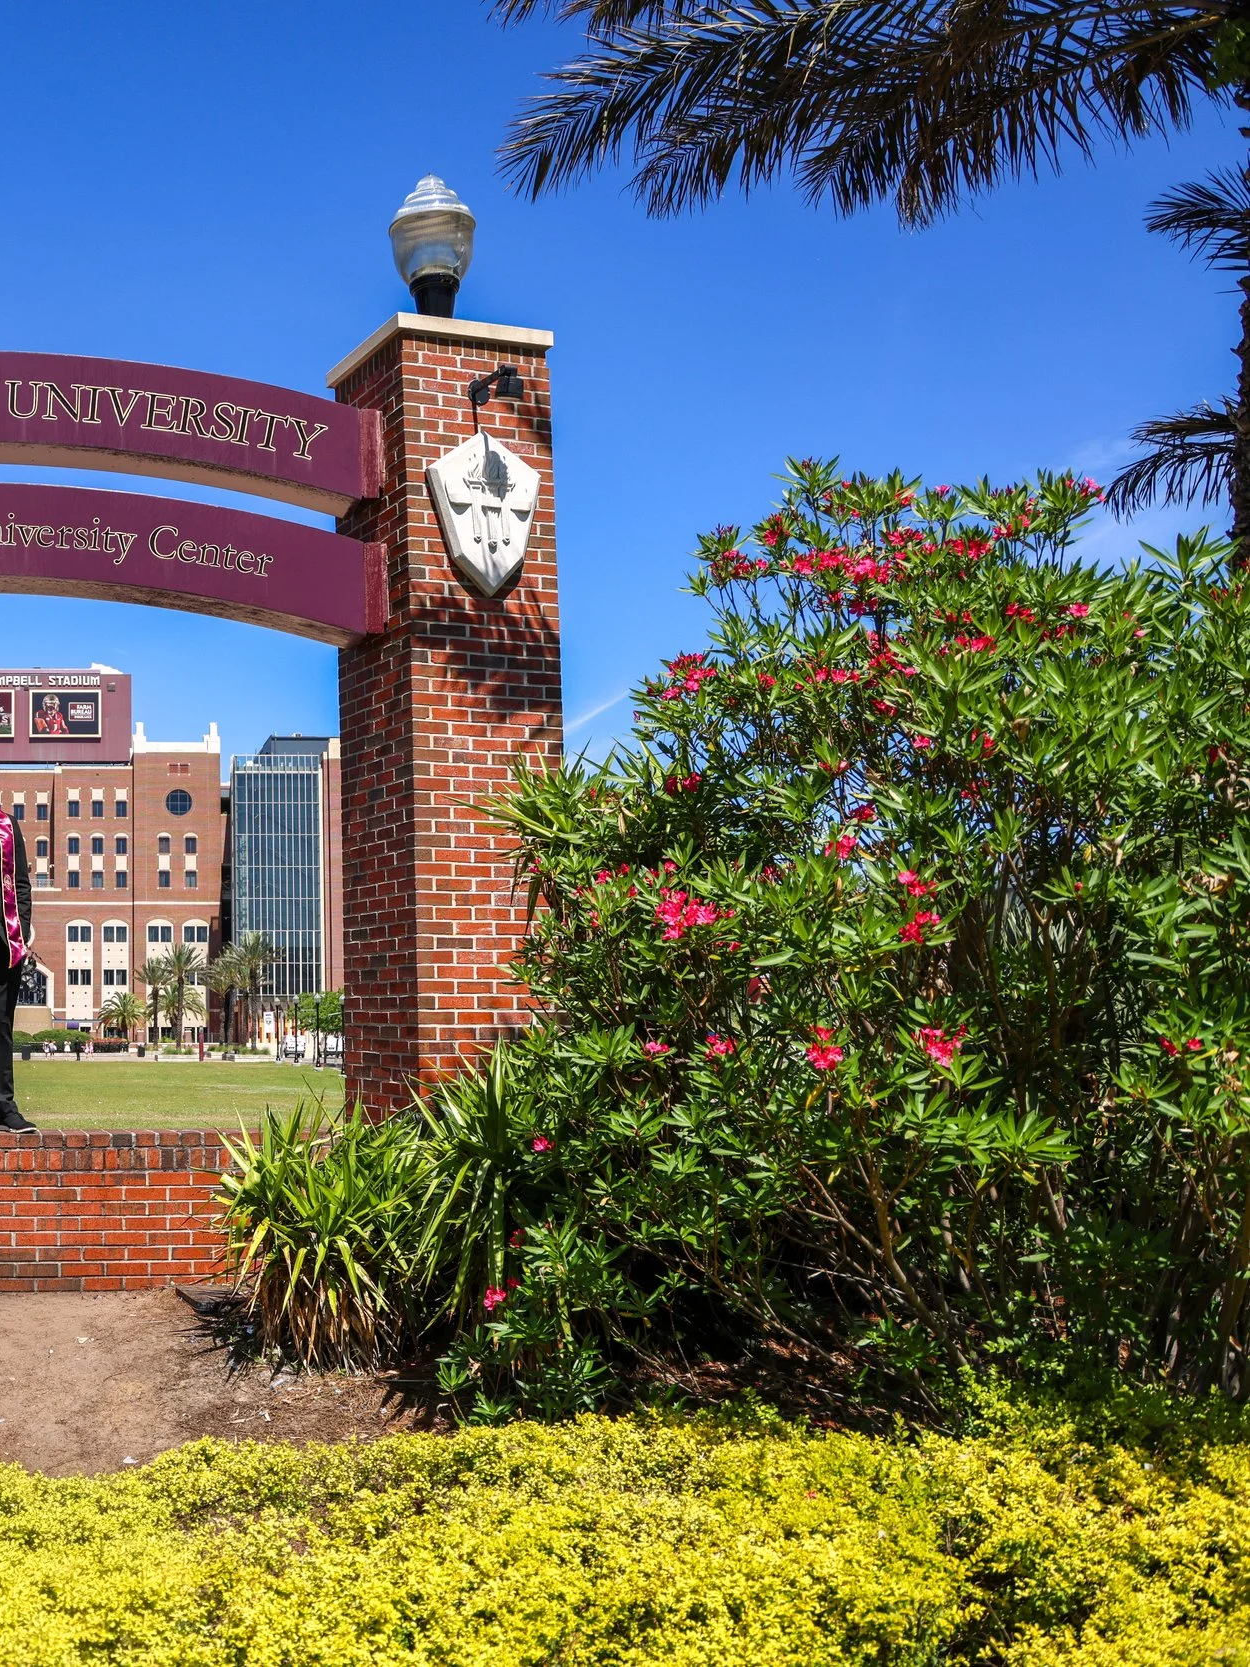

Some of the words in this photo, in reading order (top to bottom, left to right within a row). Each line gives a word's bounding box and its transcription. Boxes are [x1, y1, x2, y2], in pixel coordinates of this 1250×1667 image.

[4, 380, 328, 460] UNIVERSITY
[148, 525, 274, 577] Center
[48, 675, 101, 687] STADIUM
